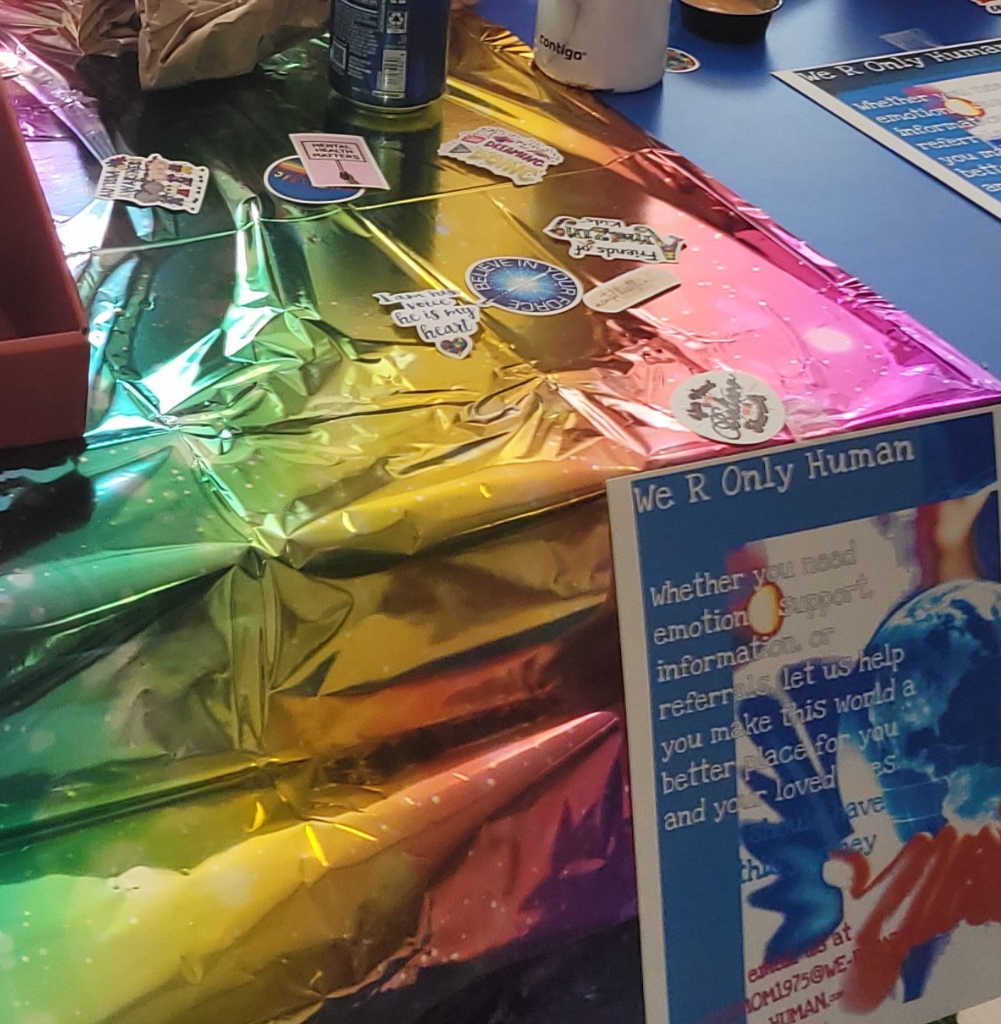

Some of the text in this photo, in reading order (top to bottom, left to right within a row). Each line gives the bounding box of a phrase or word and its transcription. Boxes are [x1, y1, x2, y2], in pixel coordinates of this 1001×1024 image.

[799, 68, 837, 83] We
[834, 64, 865, 76] R
[864, 56, 927, 73] Only
[875, 107, 954, 124] emotion
[892, 117, 981, 137] informat
[312, 142, 352, 150] MENTAL
[916, 136, 980, 151] referr
[938, 153, 980, 166] you
[517, 259, 539, 270] IN
[596, 246, 659, 262] Friends
[470, 258, 513, 291] BELIEVE
[544, 266, 577, 296] YOUR
[395, 307, 476, 325] he is my
[406, 298, 451, 310] voice
[509, 295, 571, 313] FORCE
[420, 318, 473, 340] heart
[633, 438, 916, 514] We R Only Human
[650, 571, 745, 608] Whether
[653, 608, 749, 646] emotion
[782, 664, 816, 691] let
[822, 659, 852, 681] us
[857, 643, 907, 673] help
[660, 678, 917, 763] you make this world a
[660, 758, 737, 796] better
[858, 720, 902, 748] you
[663, 797, 706, 832] and
[772, 763, 837, 803] loved
[846, 794, 886, 819] ave
[831, 921, 854, 947] at
